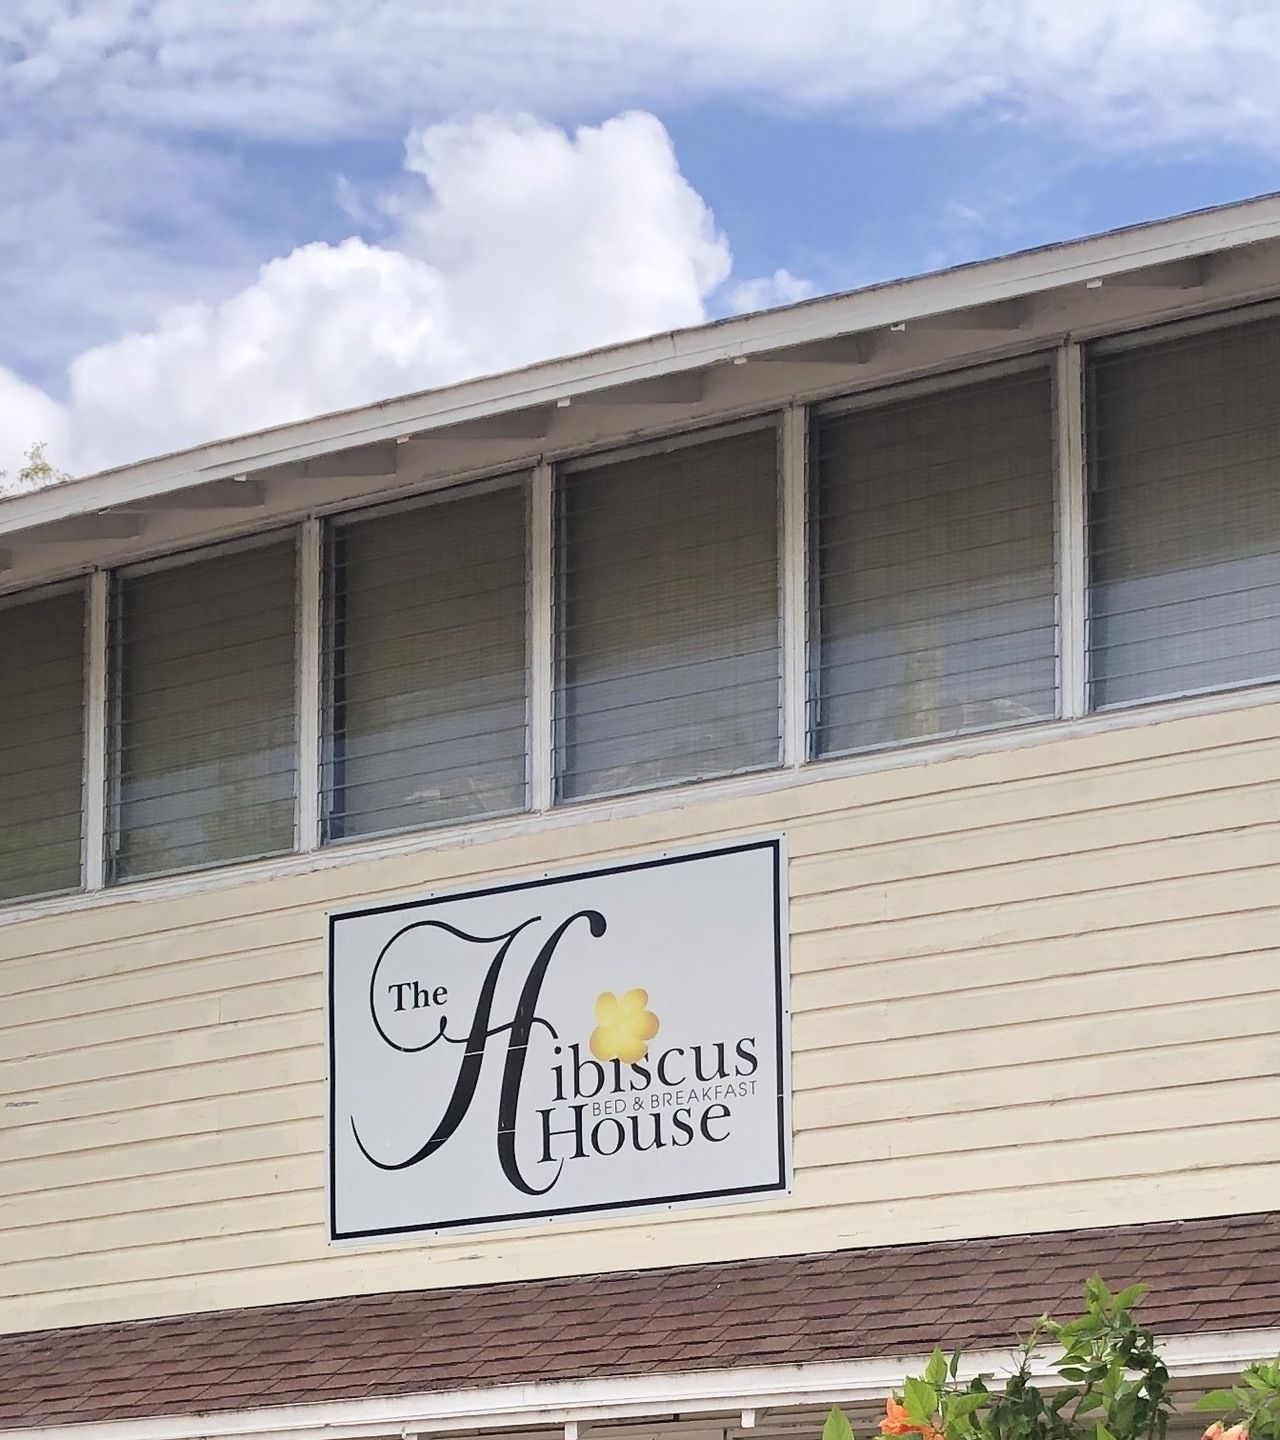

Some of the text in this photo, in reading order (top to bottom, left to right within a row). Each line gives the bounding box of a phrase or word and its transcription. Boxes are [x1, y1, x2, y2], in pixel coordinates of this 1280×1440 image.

[350, 909, 759, 1195] The Hibiscus
[592, 1080, 758, 1116] BED & BREAKFAST
[535, 1103, 731, 1164] House
